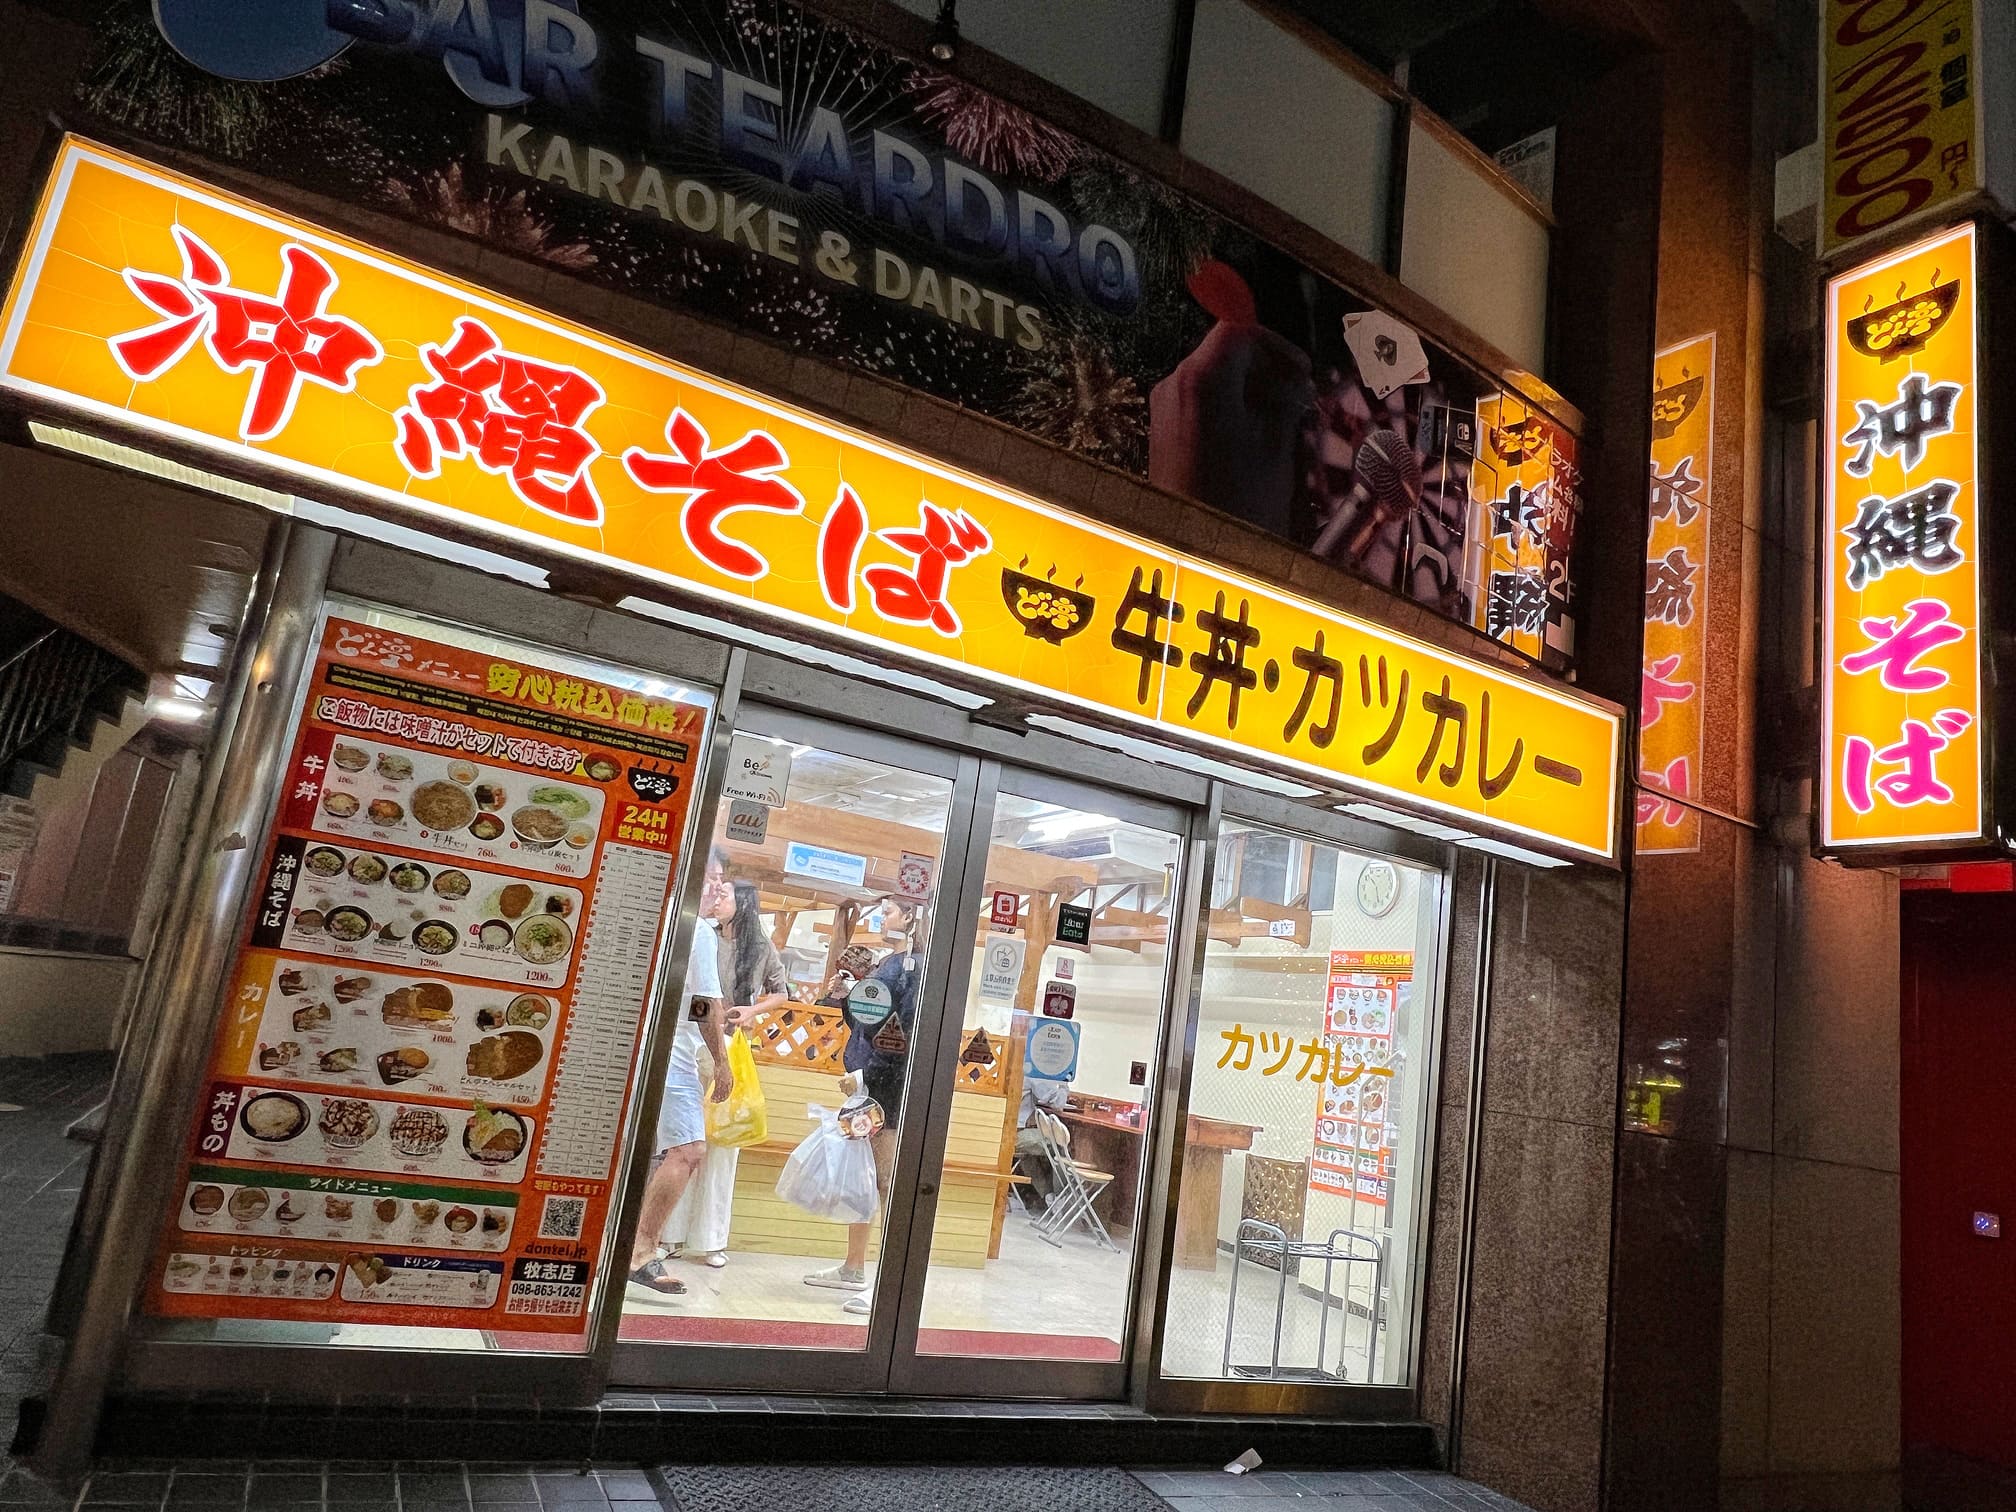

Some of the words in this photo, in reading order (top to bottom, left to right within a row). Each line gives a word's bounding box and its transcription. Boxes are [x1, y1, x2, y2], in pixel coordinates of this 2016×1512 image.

[484, 113, 800, 265] KARAOKE
[815, 229, 859, 286] &
[874, 248, 1044, 352] DARTS
[109, 224, 992, 637] 沖縄そば
[1842, 374, 1970, 813] 沖縄そば
[1111, 565, 1583, 800] 牛丼・カツカレー
[318, 697, 582, 772] ご飯物には味噌汁がセットで付きます
[294, 754, 325, 801] 牛丼
[726, 786, 744, 796] Free
[623, 805, 668, 830] 24H
[733, 813, 763, 828] au
[262, 854, 297, 927] 沖縄そば
[237, 982, 263, 1049] カレー
[1217, 1023, 1395, 1087] カツカレー
[202, 1090, 237, 1153] 丼もの
[309, 1177, 393, 1194] サイドメニュー
[403, 1257, 441, 1269] ドリンク
[523, 1261, 577, 1281] 牧志店
